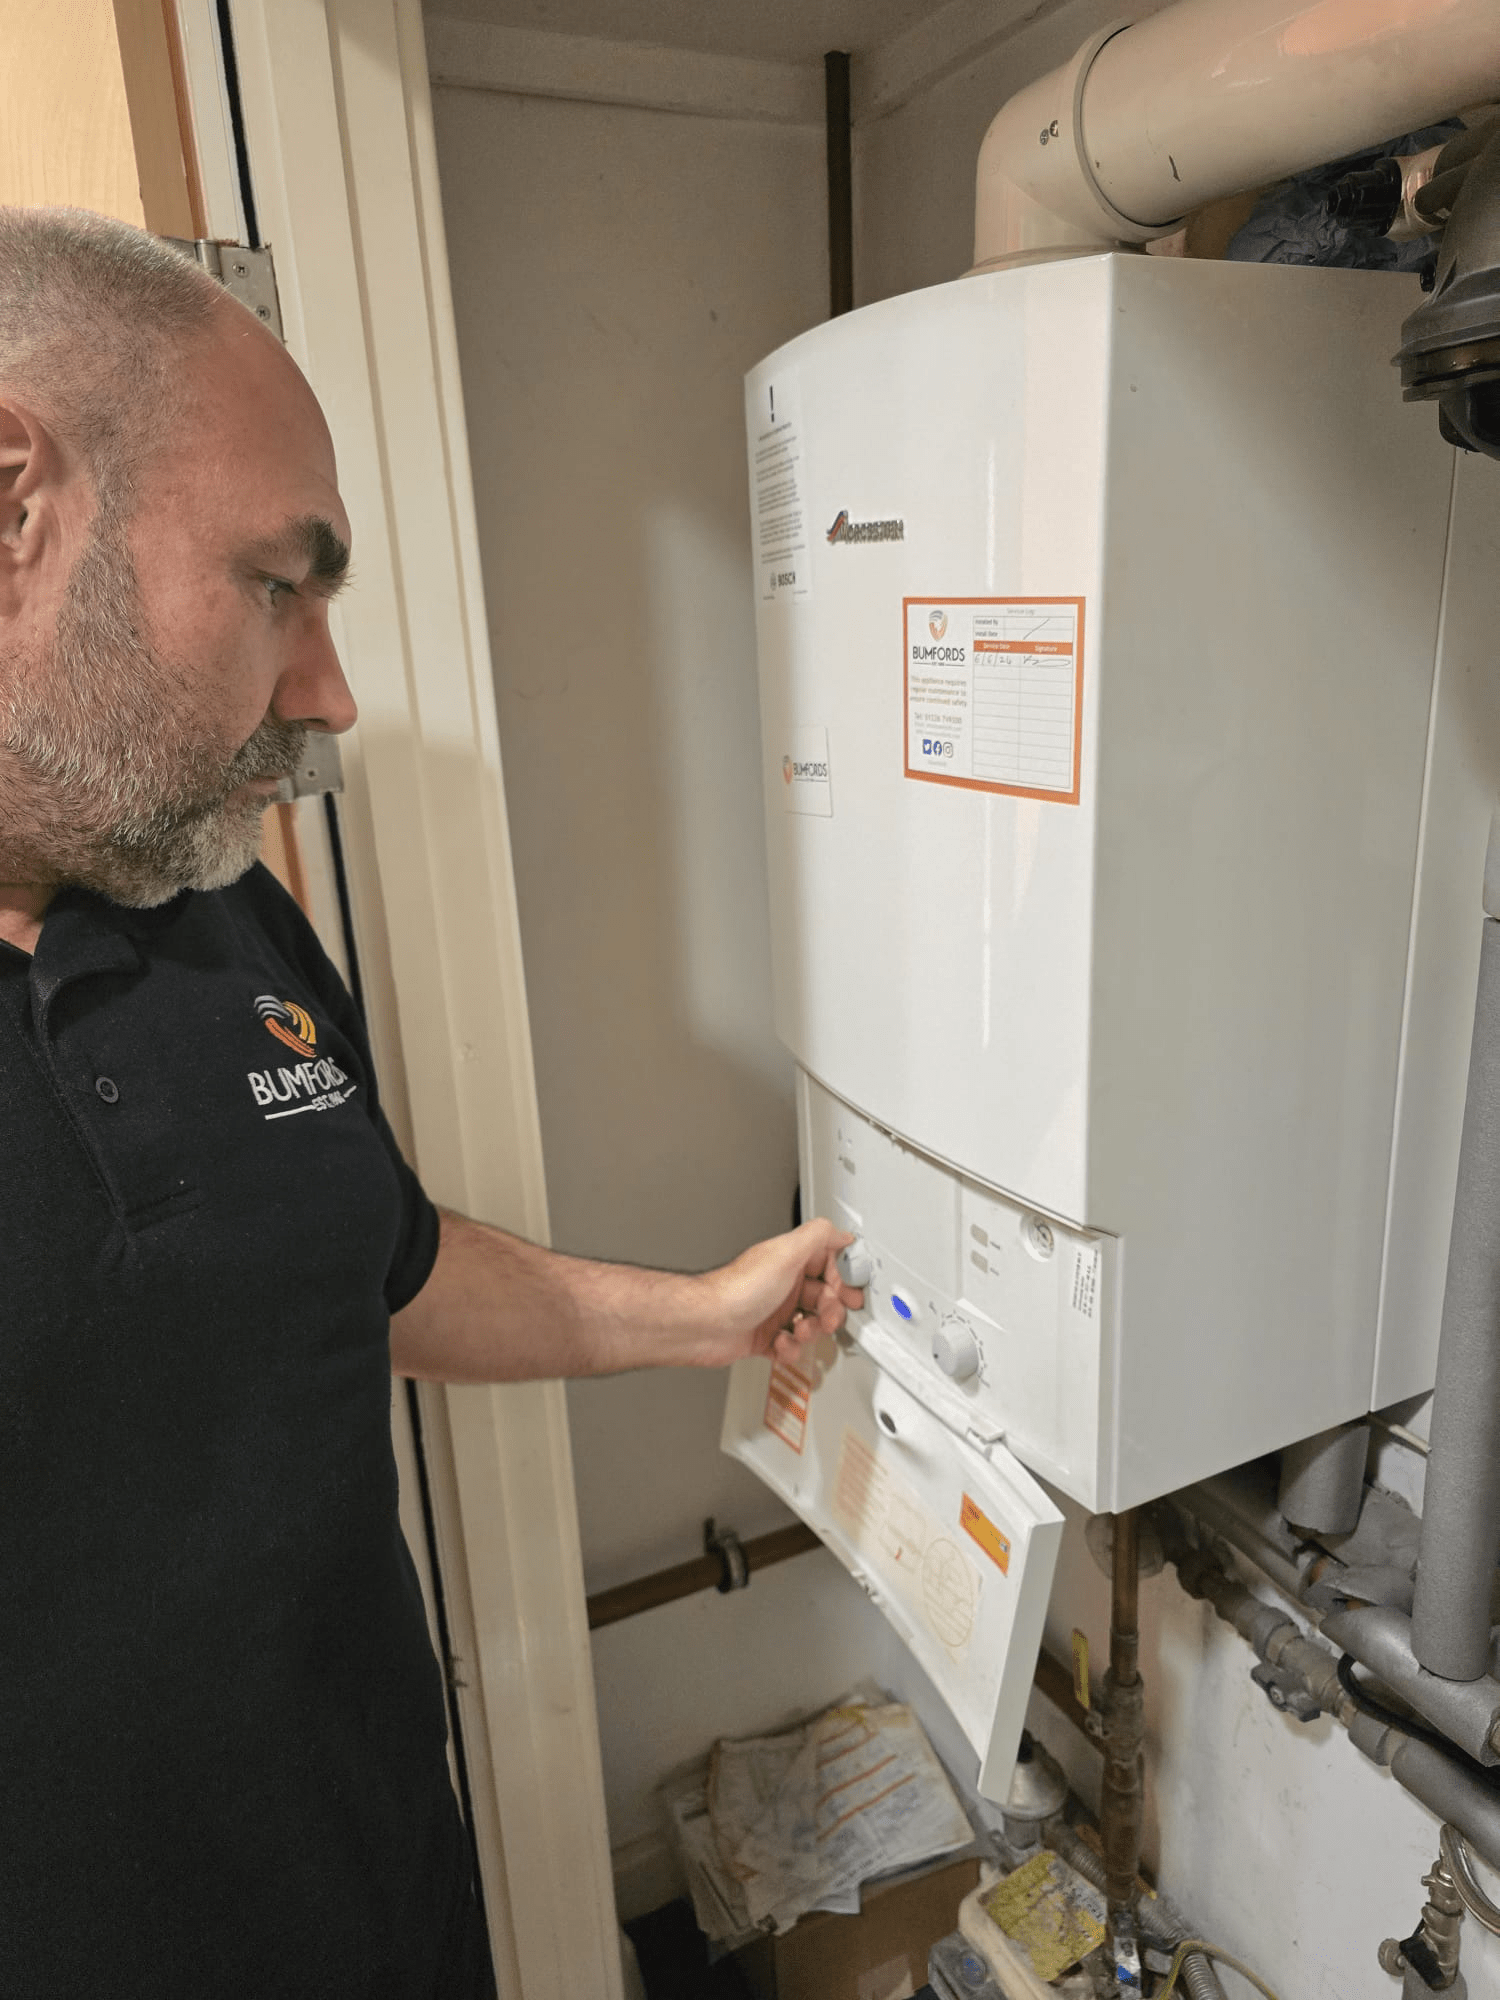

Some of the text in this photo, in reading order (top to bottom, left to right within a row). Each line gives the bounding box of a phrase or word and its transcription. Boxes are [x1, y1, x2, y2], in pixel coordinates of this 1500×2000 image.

[777, 571, 796, 588] BOSCH
[912, 645, 966, 662] BUMFORDS
[793, 763, 827, 777] BUMFORDS
[247, 1057, 348, 1105] BUMFORDS
